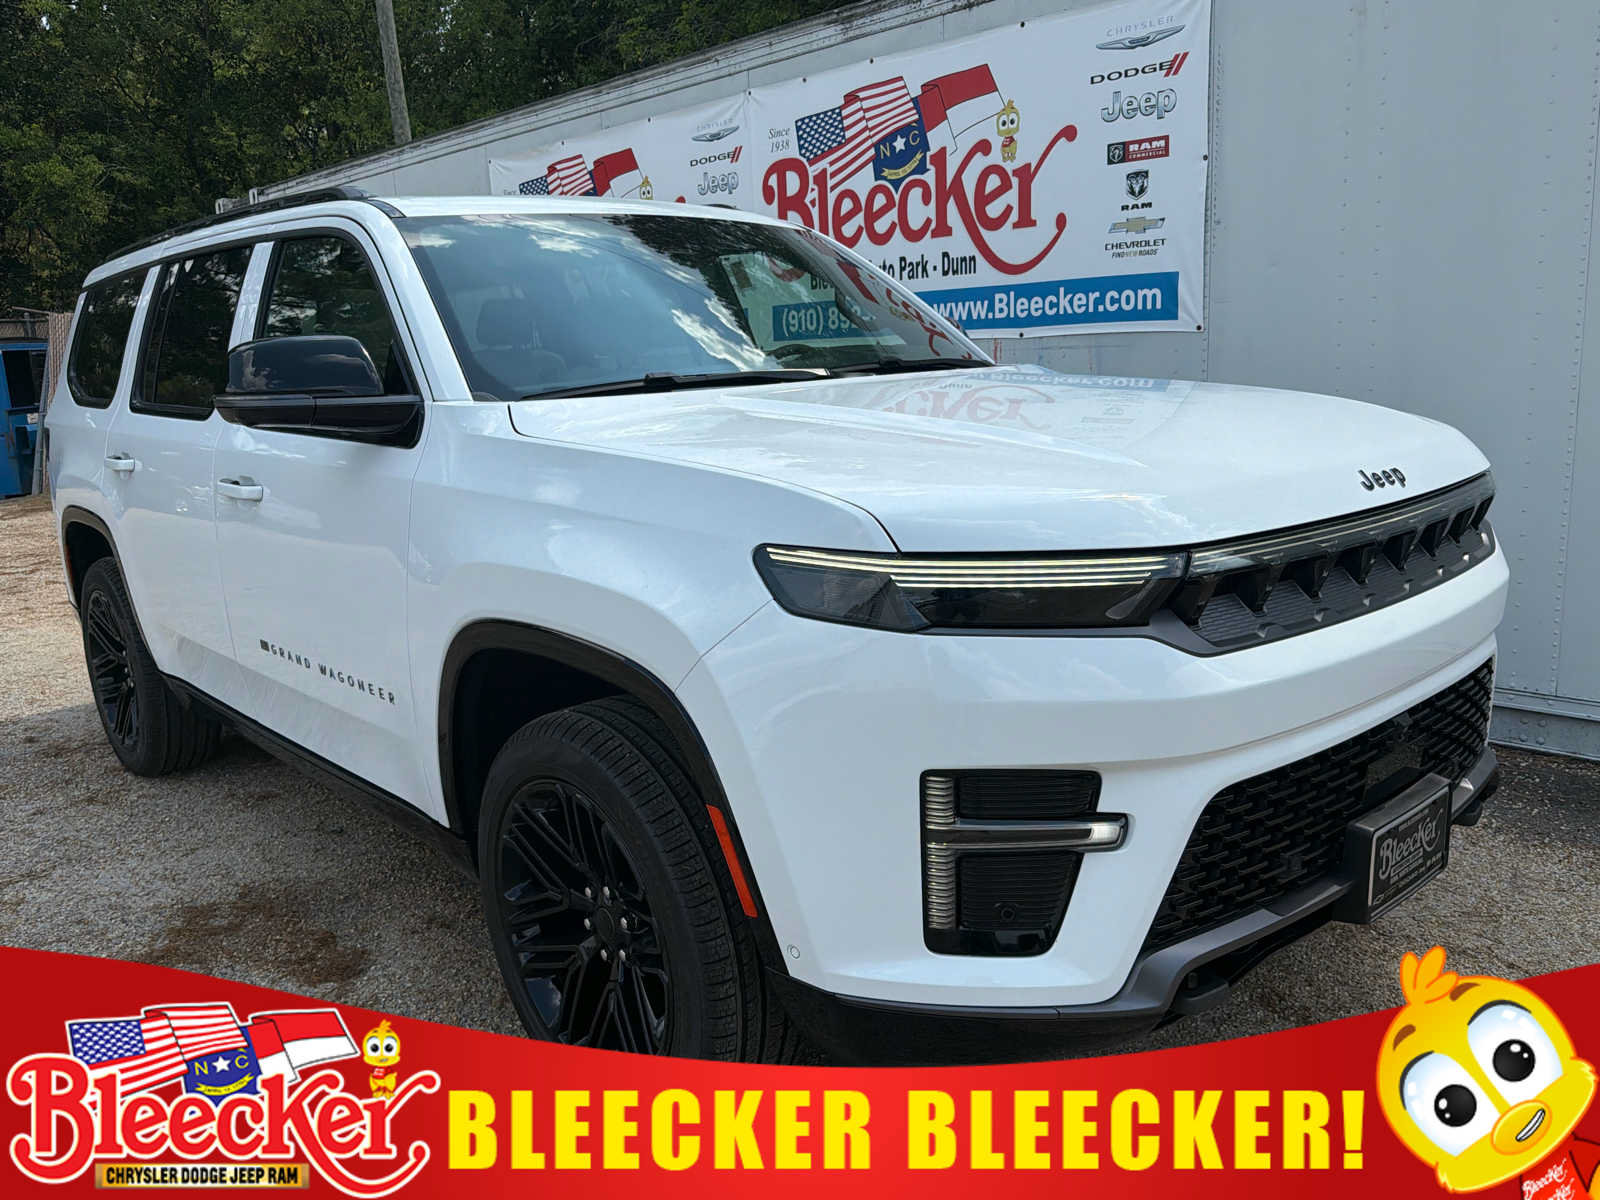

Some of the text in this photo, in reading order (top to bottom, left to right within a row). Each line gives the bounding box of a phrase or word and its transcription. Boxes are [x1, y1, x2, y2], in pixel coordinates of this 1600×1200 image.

[1106, 15, 1176, 37] CHRYSLER
[1090, 59, 1175, 85] DODGE
[1101, 88, 1177, 123] Jeep
[769, 128, 790, 139] Since
[880, 130, 920, 159] N C
[771, 140, 790, 152] 1938
[1129, 140, 1166, 152] RAM
[690, 151, 736, 167] DODGE
[698, 172, 739, 195] Jeep
[762, 124, 1077, 276] Bleecker
[1121, 202, 1153, 211] RAM
[1104, 238, 1167, 251] CHEVROLET
[899, 254, 928, 280] Park
[942, 251, 976, 277] Dunn
[932, 286, 1162, 321] www.Bleecker.com
[1358, 467, 1406, 491] Jeep
[270, 644, 396, 705] GRAND WAGONEER
[1379, 808, 1443, 879] Bleecker
